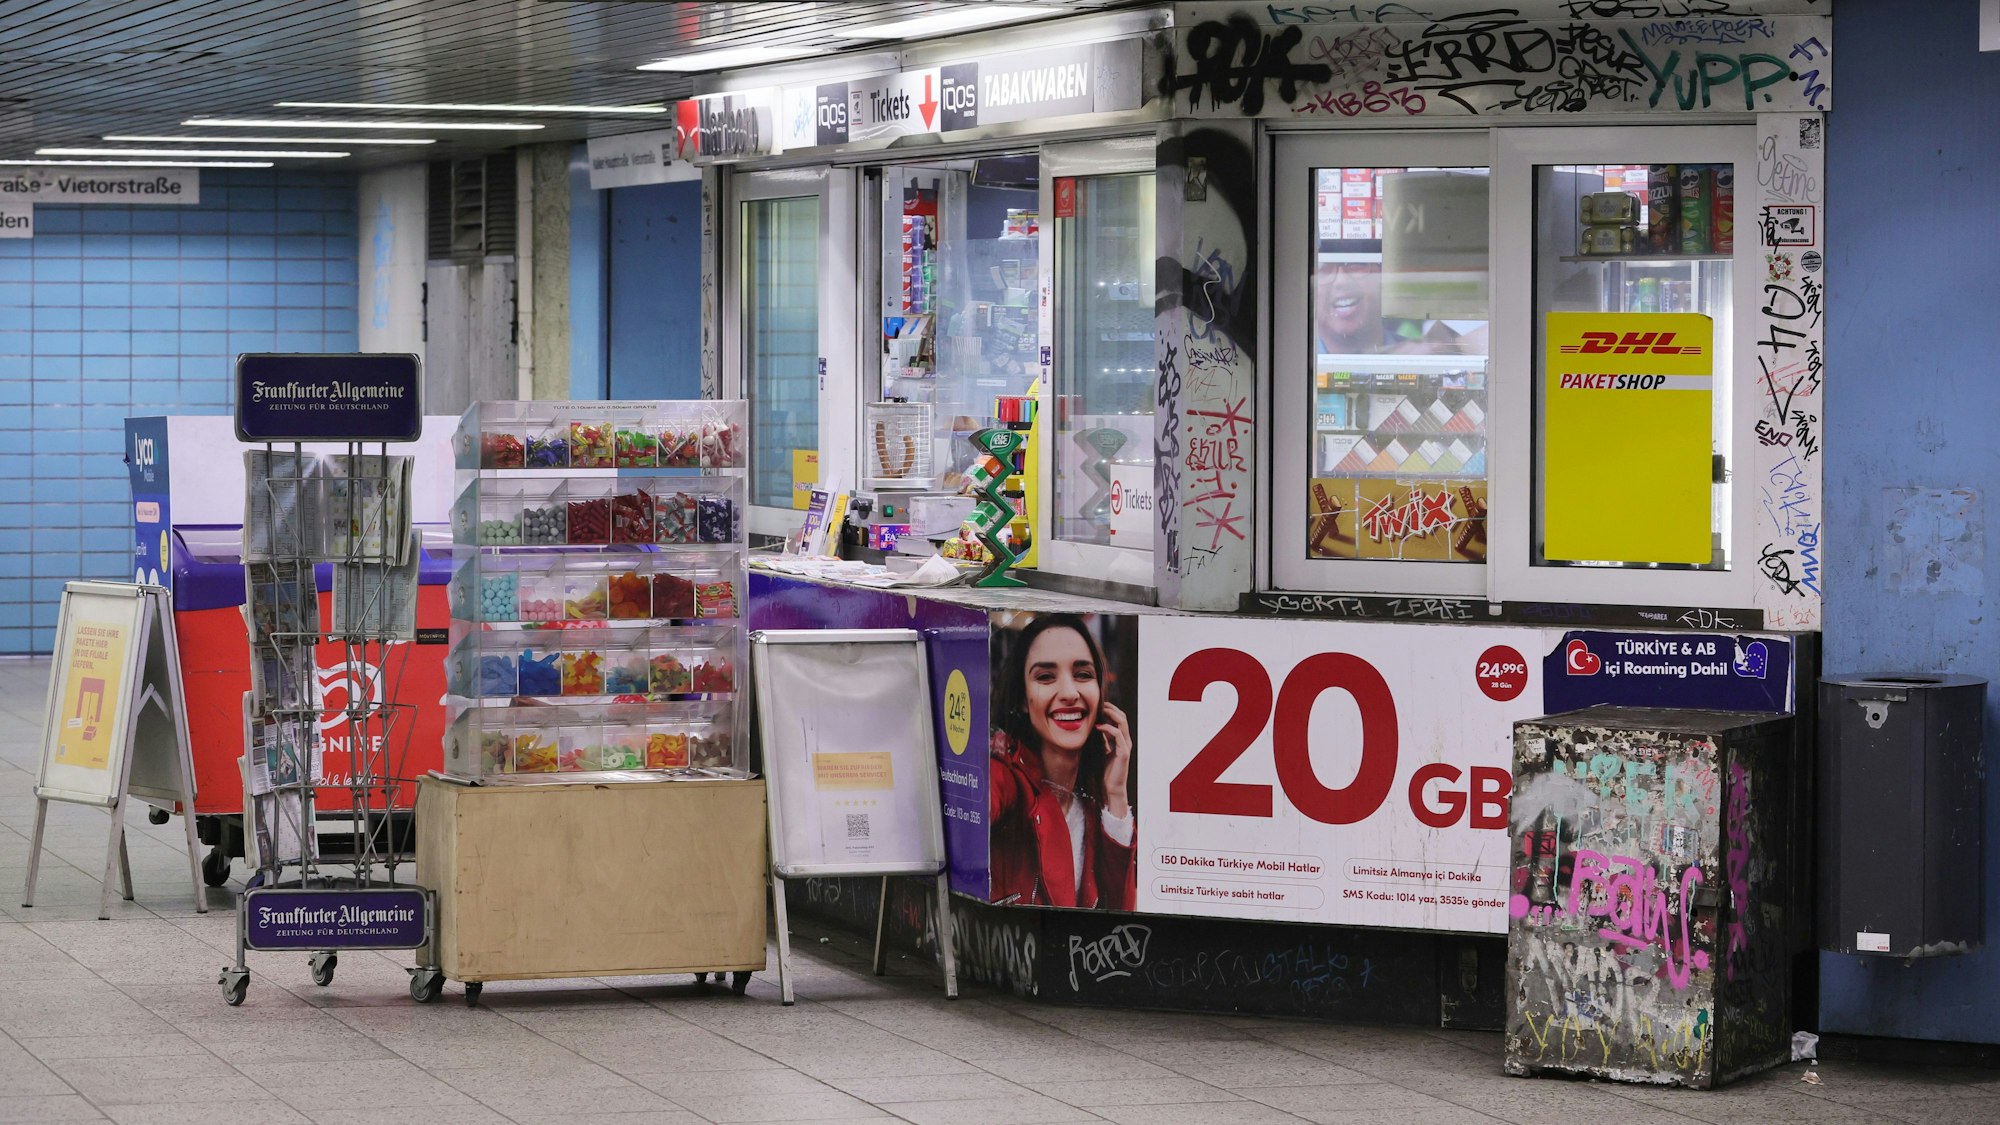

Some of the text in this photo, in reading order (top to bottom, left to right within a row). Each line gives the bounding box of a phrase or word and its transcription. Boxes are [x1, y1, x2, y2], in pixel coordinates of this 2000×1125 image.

[985, 62, 1088, 107] TABAKWAREN
[870, 87, 910, 123] Tickets
[943, 84, 975, 114] IQOS
[818, 102, 846, 130] IQOS
[58, 176, 182, 195] Vietorstraße
[1579, 331, 1683, 355] DHL
[1560, 373, 1666, 390] PAKETSHOP
[252, 380, 405, 404] Frankfurter Allgemeine
[269, 402, 389, 411] ZEITUNG FÜR DEUTSCHLAND
[134, 432, 154, 472] Lyca
[1125, 489, 1152, 511] Tickets
[1362, 488, 1457, 542] Twix
[77, 627, 98, 636] LASSEN
[1616, 640, 1717, 656] TÜRKİYE & AB
[1479, 660, 1525, 679] 24,99€
[1605, 661, 1728, 679] içi Roaming Dahil
[320, 735, 385, 753] GNESE
[1168, 647, 1399, 825] 20
[1408, 763, 1513, 830] GB
[332, 773, 340, 786] &
[968, 772, 979, 789] Flat
[1161, 855, 1321, 873] 150 Dakika Türkiye Mobil Hatlar
[1353, 866, 1482, 883] Limitsiz Almanya içi Dakika
[1160, 884, 1285, 901] Limitsiz Türkiye sabit hatlar
[1342, 889, 1364, 899] SMS
[1366, 891, 1394, 901] Kodu:
[1396, 892, 1416, 902] 1014
[1440, 895, 1469, 906] 3535'e
[1471, 897, 1506, 909] gönder
[258, 904, 415, 928] Frankfurter Allgemeine
[276, 927, 399, 937] ZEITUNG FÜR DEUTSCHLAND
